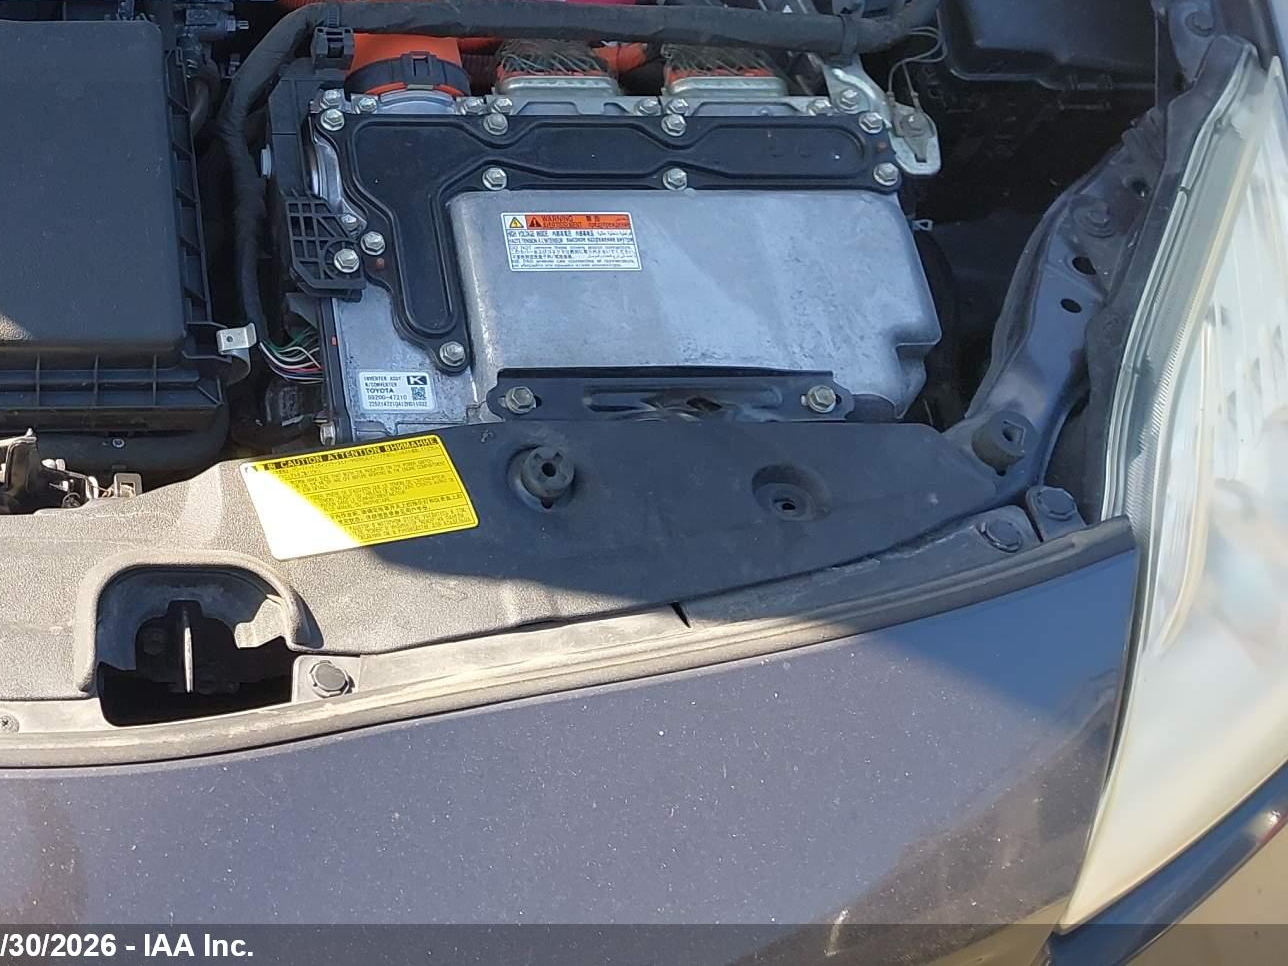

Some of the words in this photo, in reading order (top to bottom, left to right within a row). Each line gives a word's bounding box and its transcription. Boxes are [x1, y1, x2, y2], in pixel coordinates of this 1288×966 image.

[281, 455, 322, 469] CAUTION
[327, 446, 382, 462] ATTENTION
[384, 438, 437, 454] ВНИМАНИЕ
